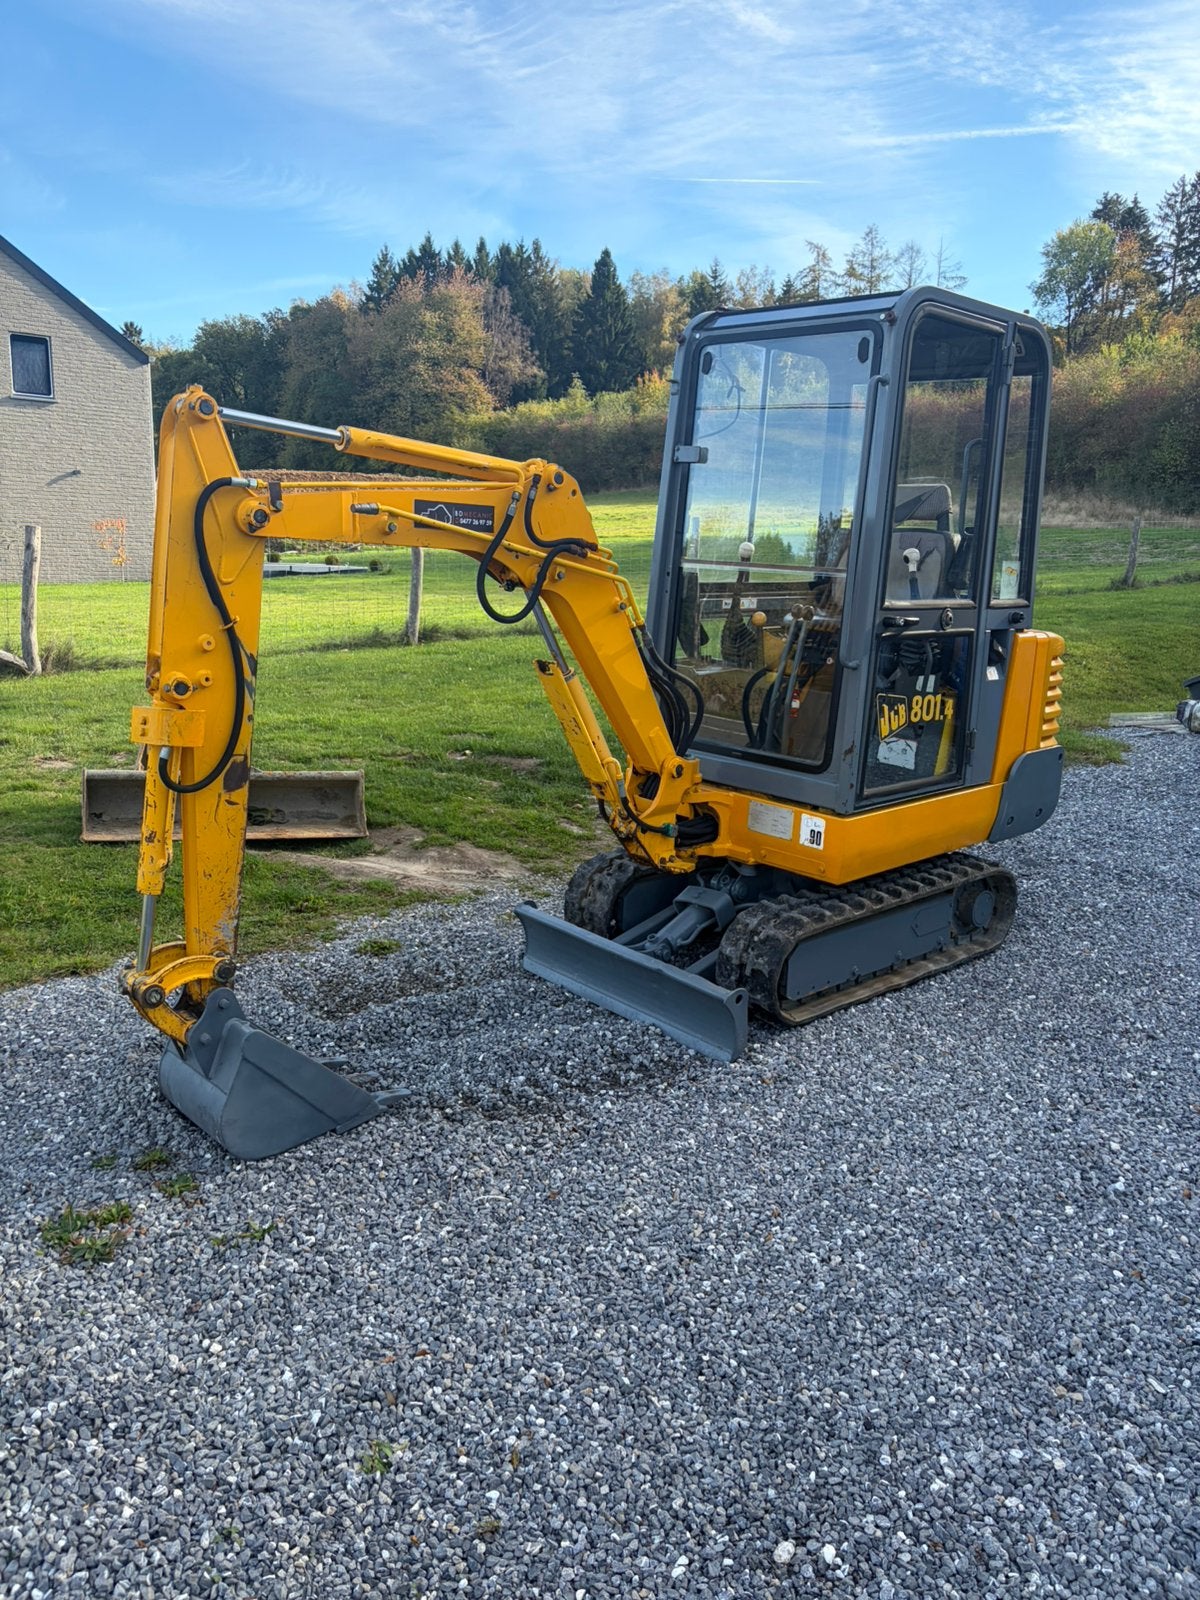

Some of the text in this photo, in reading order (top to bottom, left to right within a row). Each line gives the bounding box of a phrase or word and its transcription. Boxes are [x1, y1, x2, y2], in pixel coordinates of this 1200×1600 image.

[880, 694, 954, 738] JCB 801.4
[810, 829, 822, 846] 90
